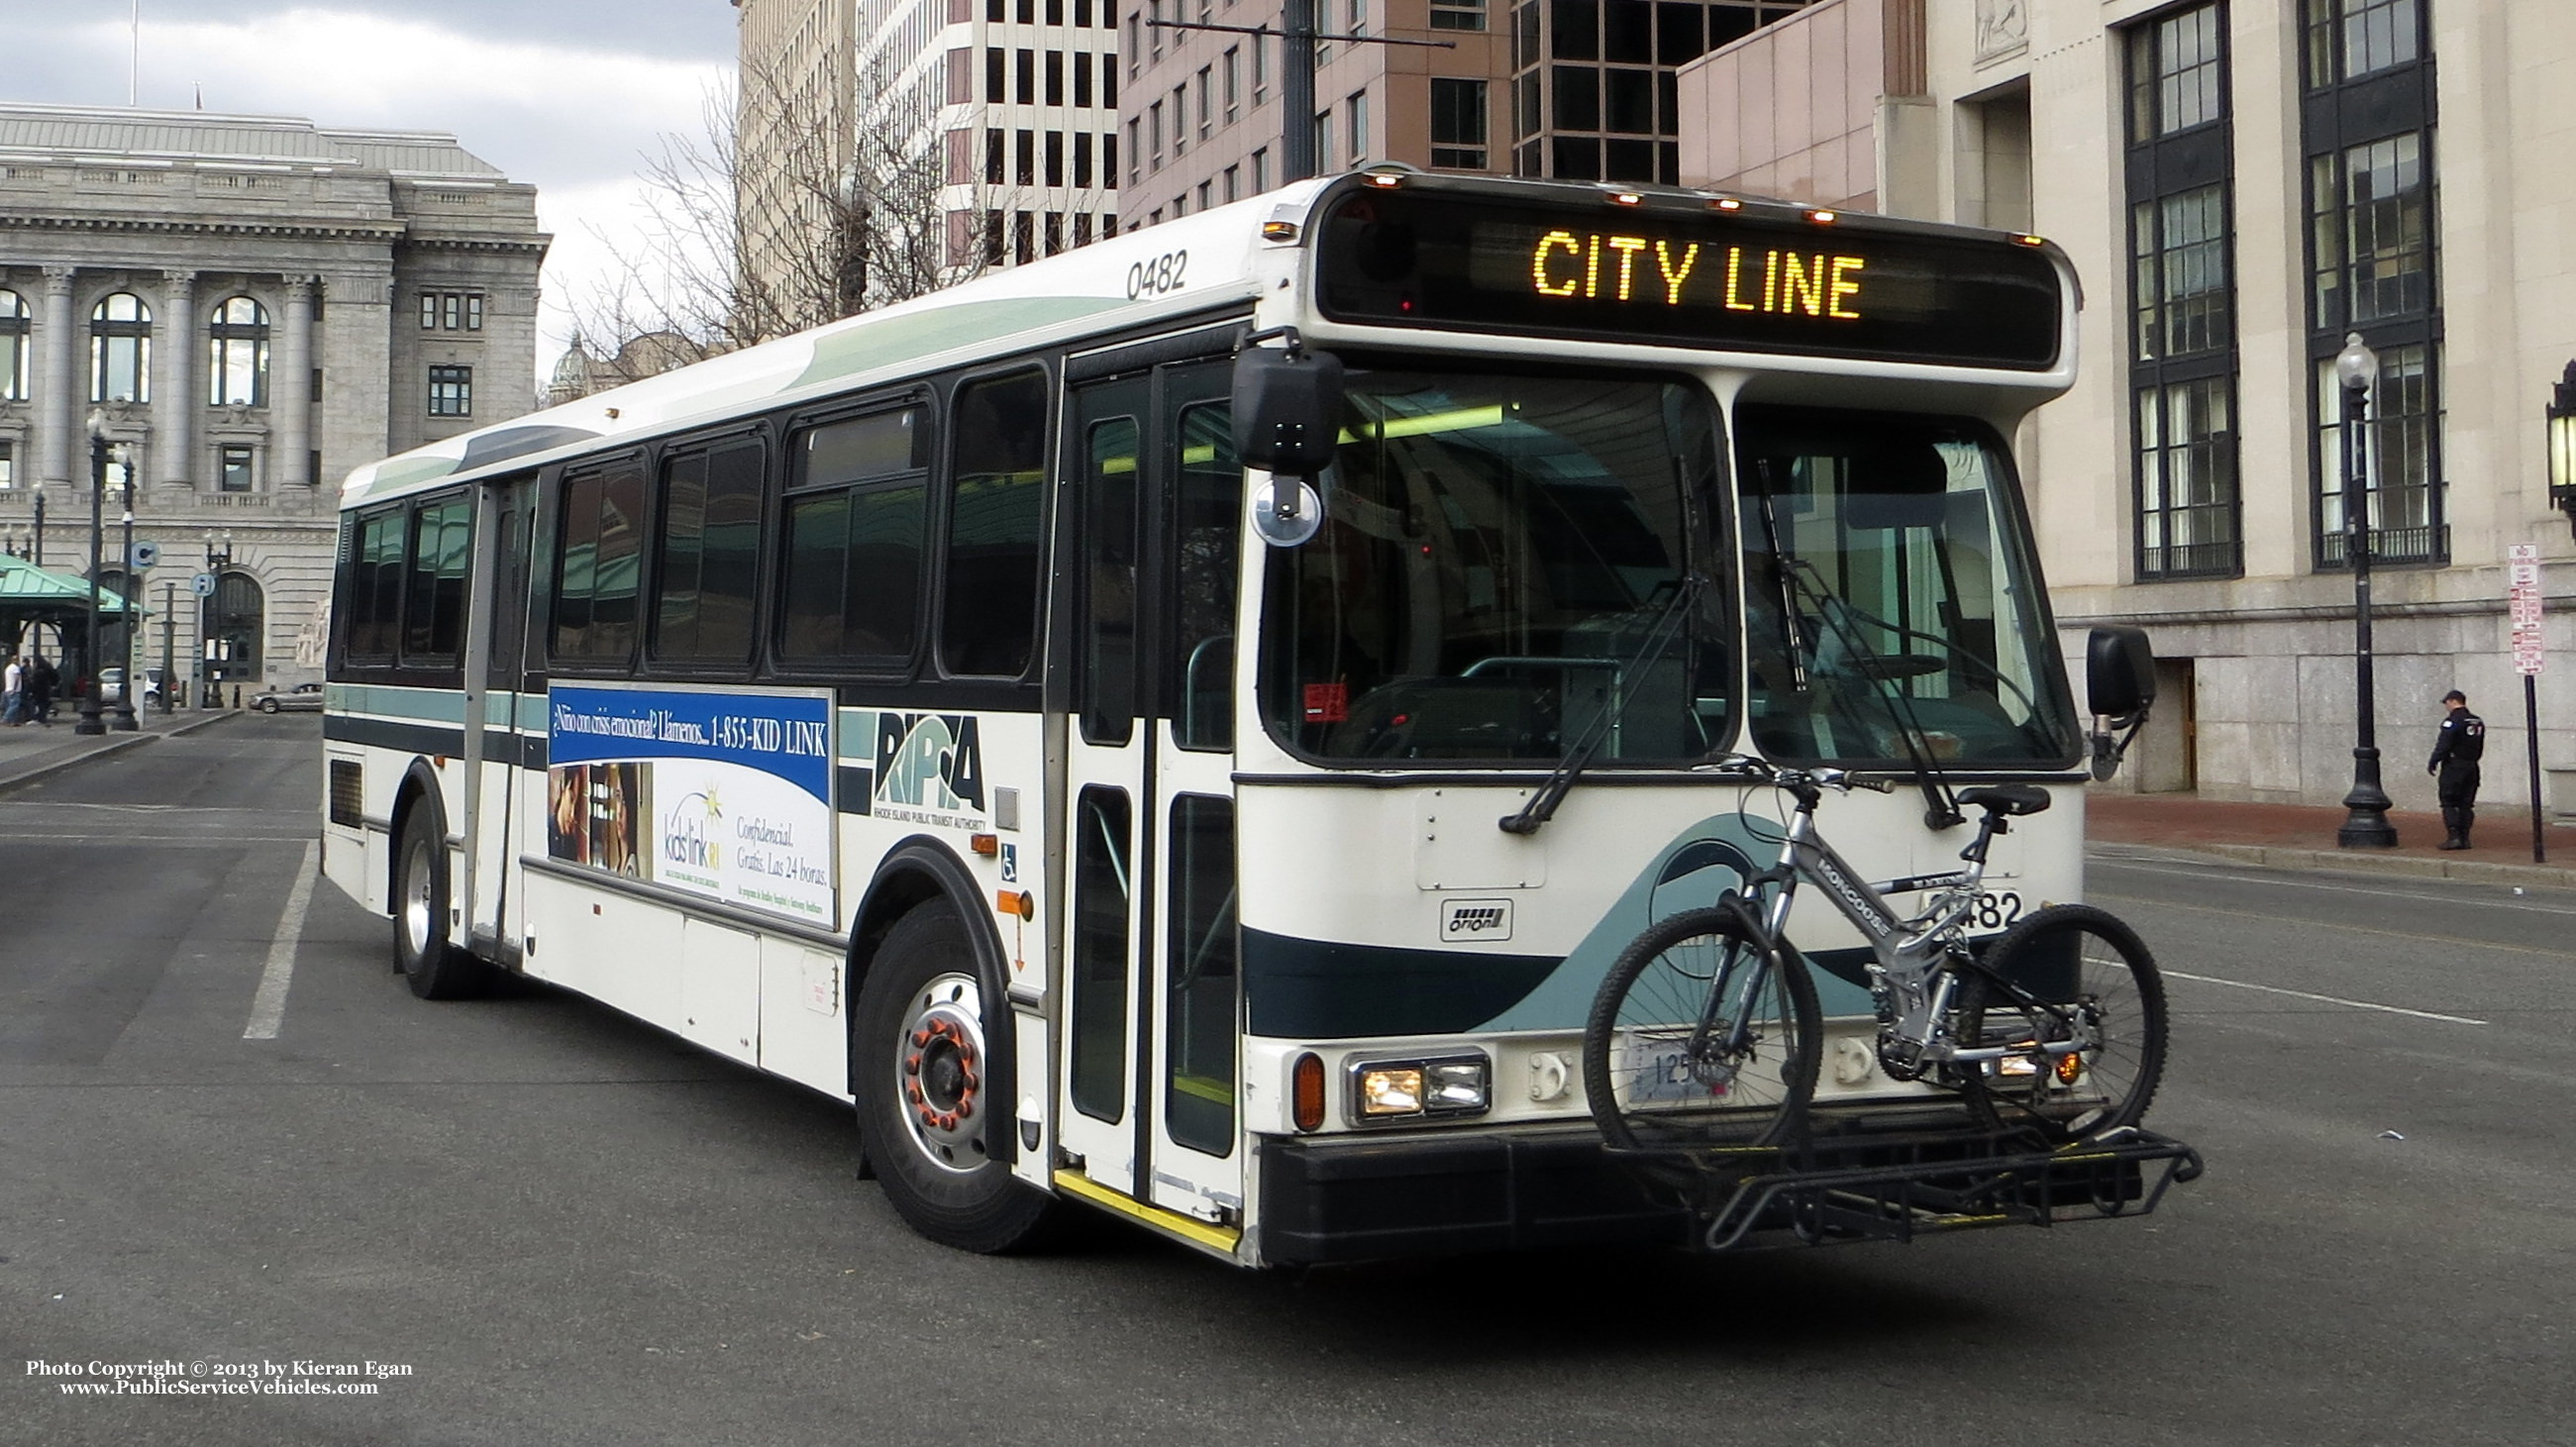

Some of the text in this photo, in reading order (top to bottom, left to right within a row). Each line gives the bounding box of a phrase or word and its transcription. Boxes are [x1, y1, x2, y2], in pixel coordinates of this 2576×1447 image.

[1127, 249, 1187, 301] 0482
[1533, 231, 1864, 319] CITY LINE
[576, 713, 590, 733] con
[712, 715, 780, 752] 1-855-KID
[785, 720, 826, 758] LINK
[875, 712, 986, 813] RIPTA
[737, 815, 793, 848] Confidencial.
[875, 807, 985, 832] RHODE ISLAND PUBLIC TRANSIT AUTHORITY
[768, 852, 783, 878] Las
[785, 856, 797, 880] 24
[1817, 858, 1891, 937] MONGOOSE
